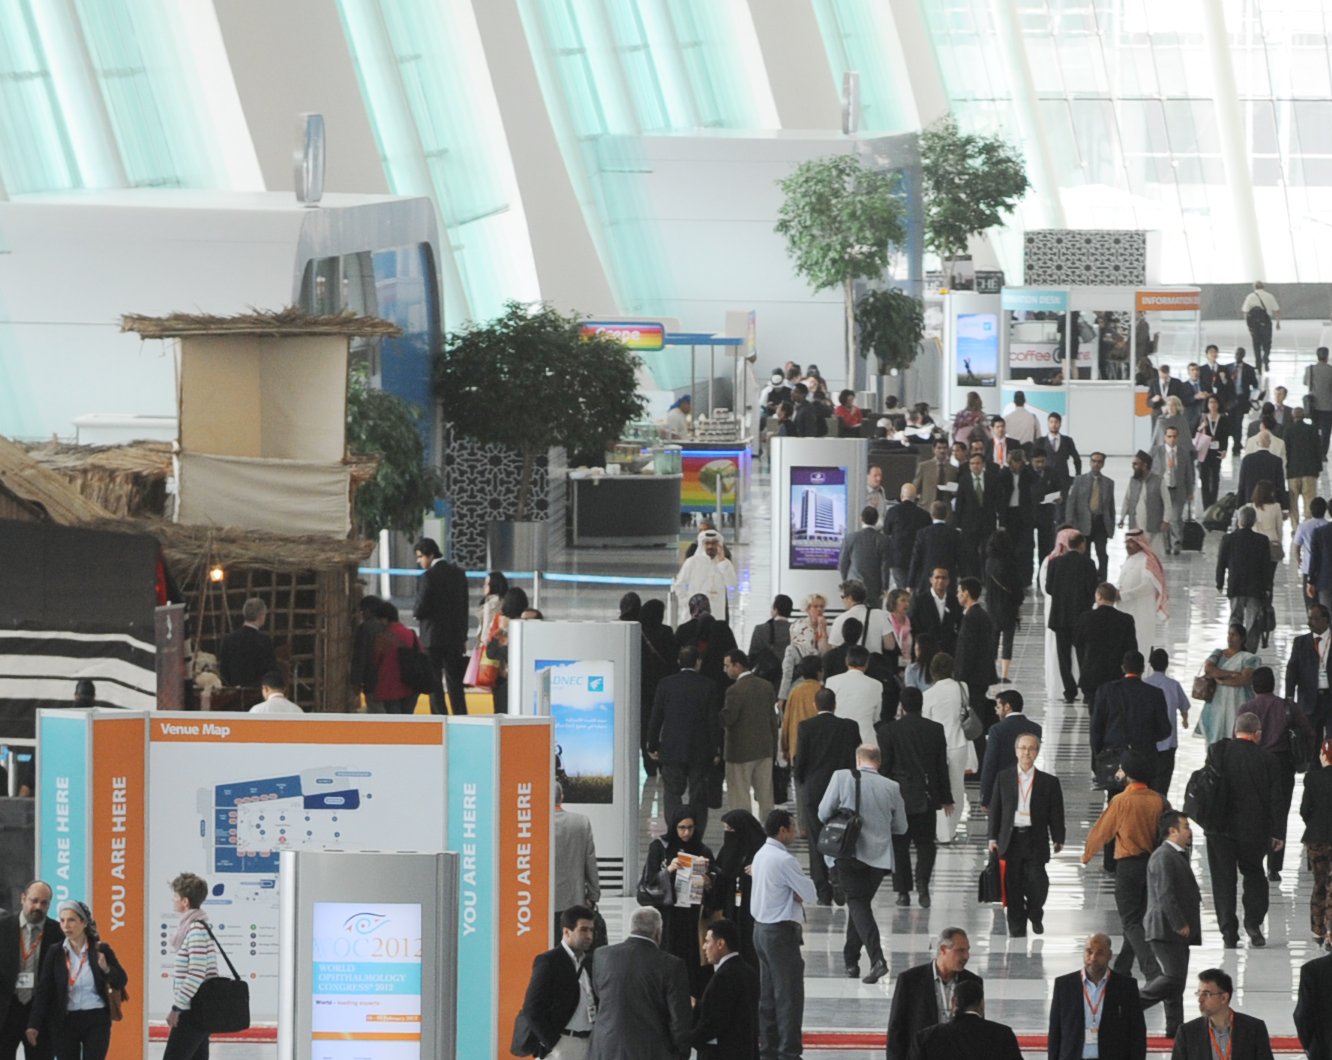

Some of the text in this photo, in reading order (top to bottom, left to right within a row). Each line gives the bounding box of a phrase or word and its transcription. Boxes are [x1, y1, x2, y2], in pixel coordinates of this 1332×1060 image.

[1009, 350, 1051, 361] coffee
[551, 675, 584, 686] DNEC
[160, 723, 231, 738] Venue Map
[56, 776, 70, 833] HERE
[57, 837, 71, 881] ARE
[110, 776, 127, 932] YOU ARE HERE
[463, 782, 477, 937] YOU ARE HERE
[517, 782, 532, 937] YOU ARE HERE
[319, 964, 356, 973] WORLD
[319, 973, 407, 983] OPHTHALMOLOGY
[375, 983, 395, 992] 2012
